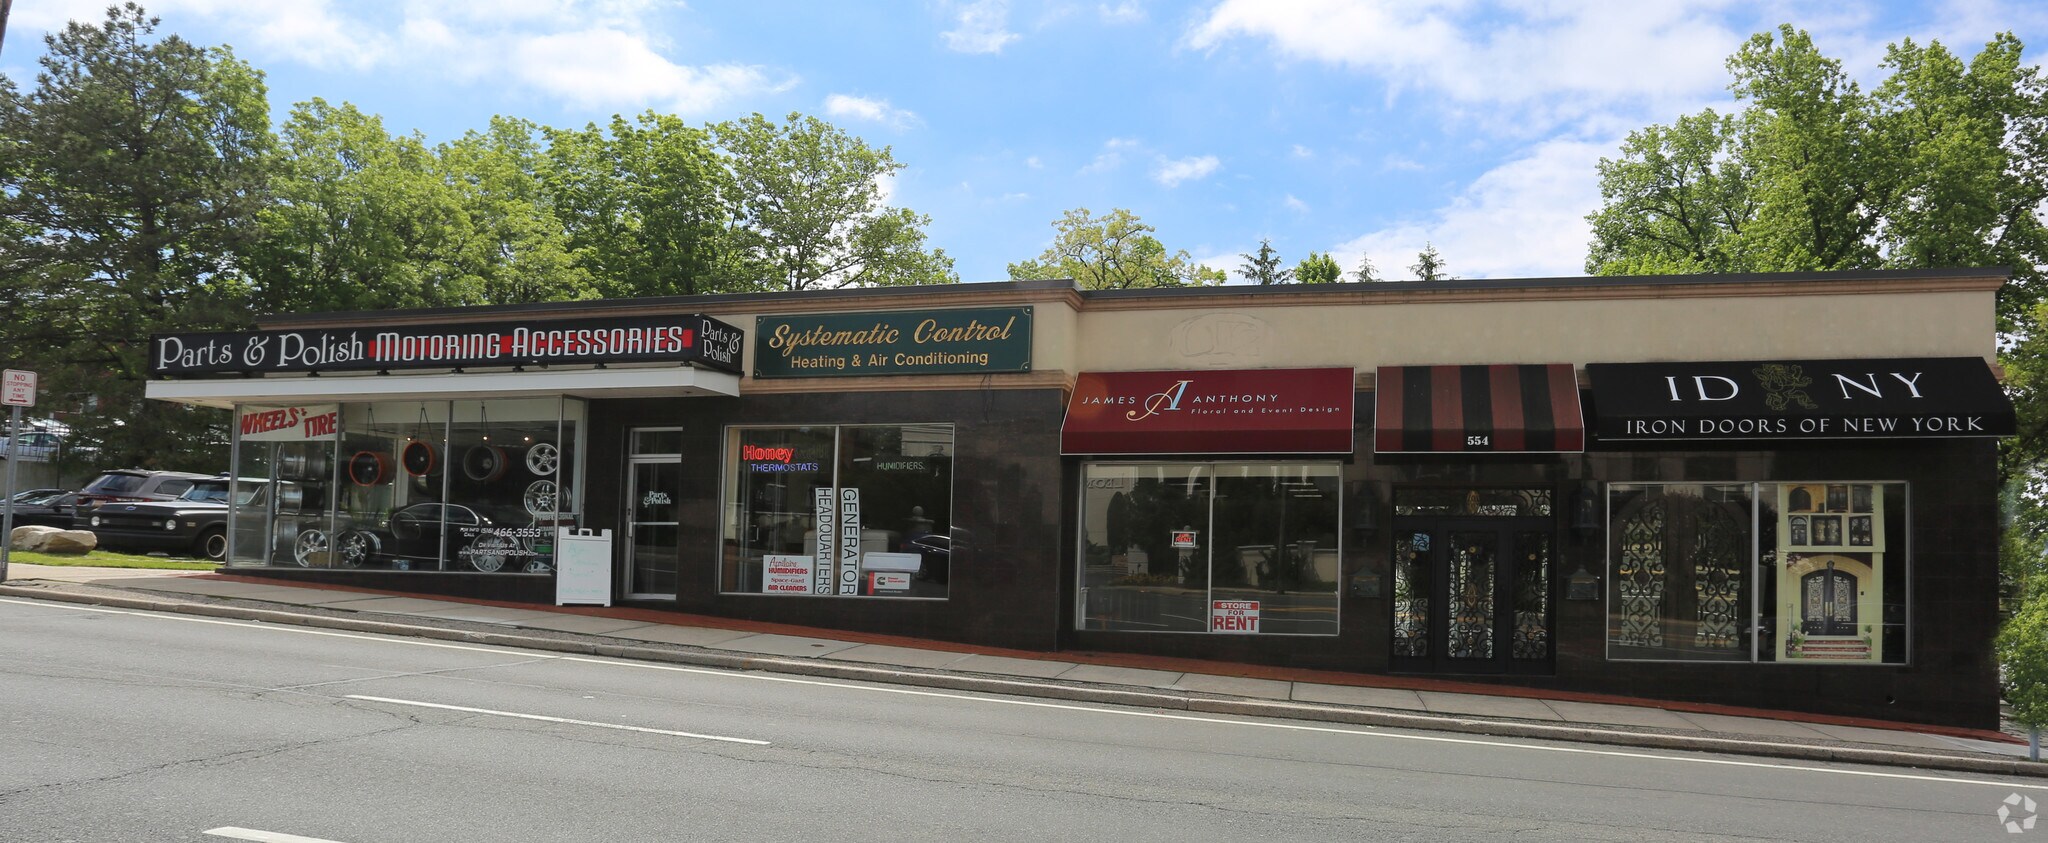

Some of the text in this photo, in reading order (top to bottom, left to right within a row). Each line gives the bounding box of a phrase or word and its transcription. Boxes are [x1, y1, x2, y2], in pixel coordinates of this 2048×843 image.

[702, 319, 728, 343] Parts
[769, 315, 1016, 357] Systematic Control
[157, 336, 233, 370] Parts
[243, 335, 270, 366] &
[276, 330, 364, 367] Polish
[703, 339, 731, 363] Polish
[729, 333, 742, 354] &
[791, 351, 989, 370] Heating & Air Conditioning
[14, 374, 26, 382] NO
[1664, 372, 1924, 402] ID NY
[1082, 396, 1137, 405] JAMES
[1192, 394, 1279, 403] ANTHONY
[1300, 405, 1341, 414] Design
[240, 406, 300, 436] WHEELS
[1626, 415, 1985, 435] IRON DOORS OF NEW YORK
[1467, 435, 1489, 446] 554
[743, 444, 795, 464] Honey
[751, 462, 819, 472] THERMOSTATS
[649, 490, 668, 498] Parts
[650, 497, 671, 505] Polish
[493, 527, 541, 538] 466-3553
[816, 488, 832, 595] HEADQUARTERS
[841, 488, 858, 596] GENERATOR
[768, 567, 808, 575] HUMIDIFIERS
[1213, 615, 1259, 631] RENT
